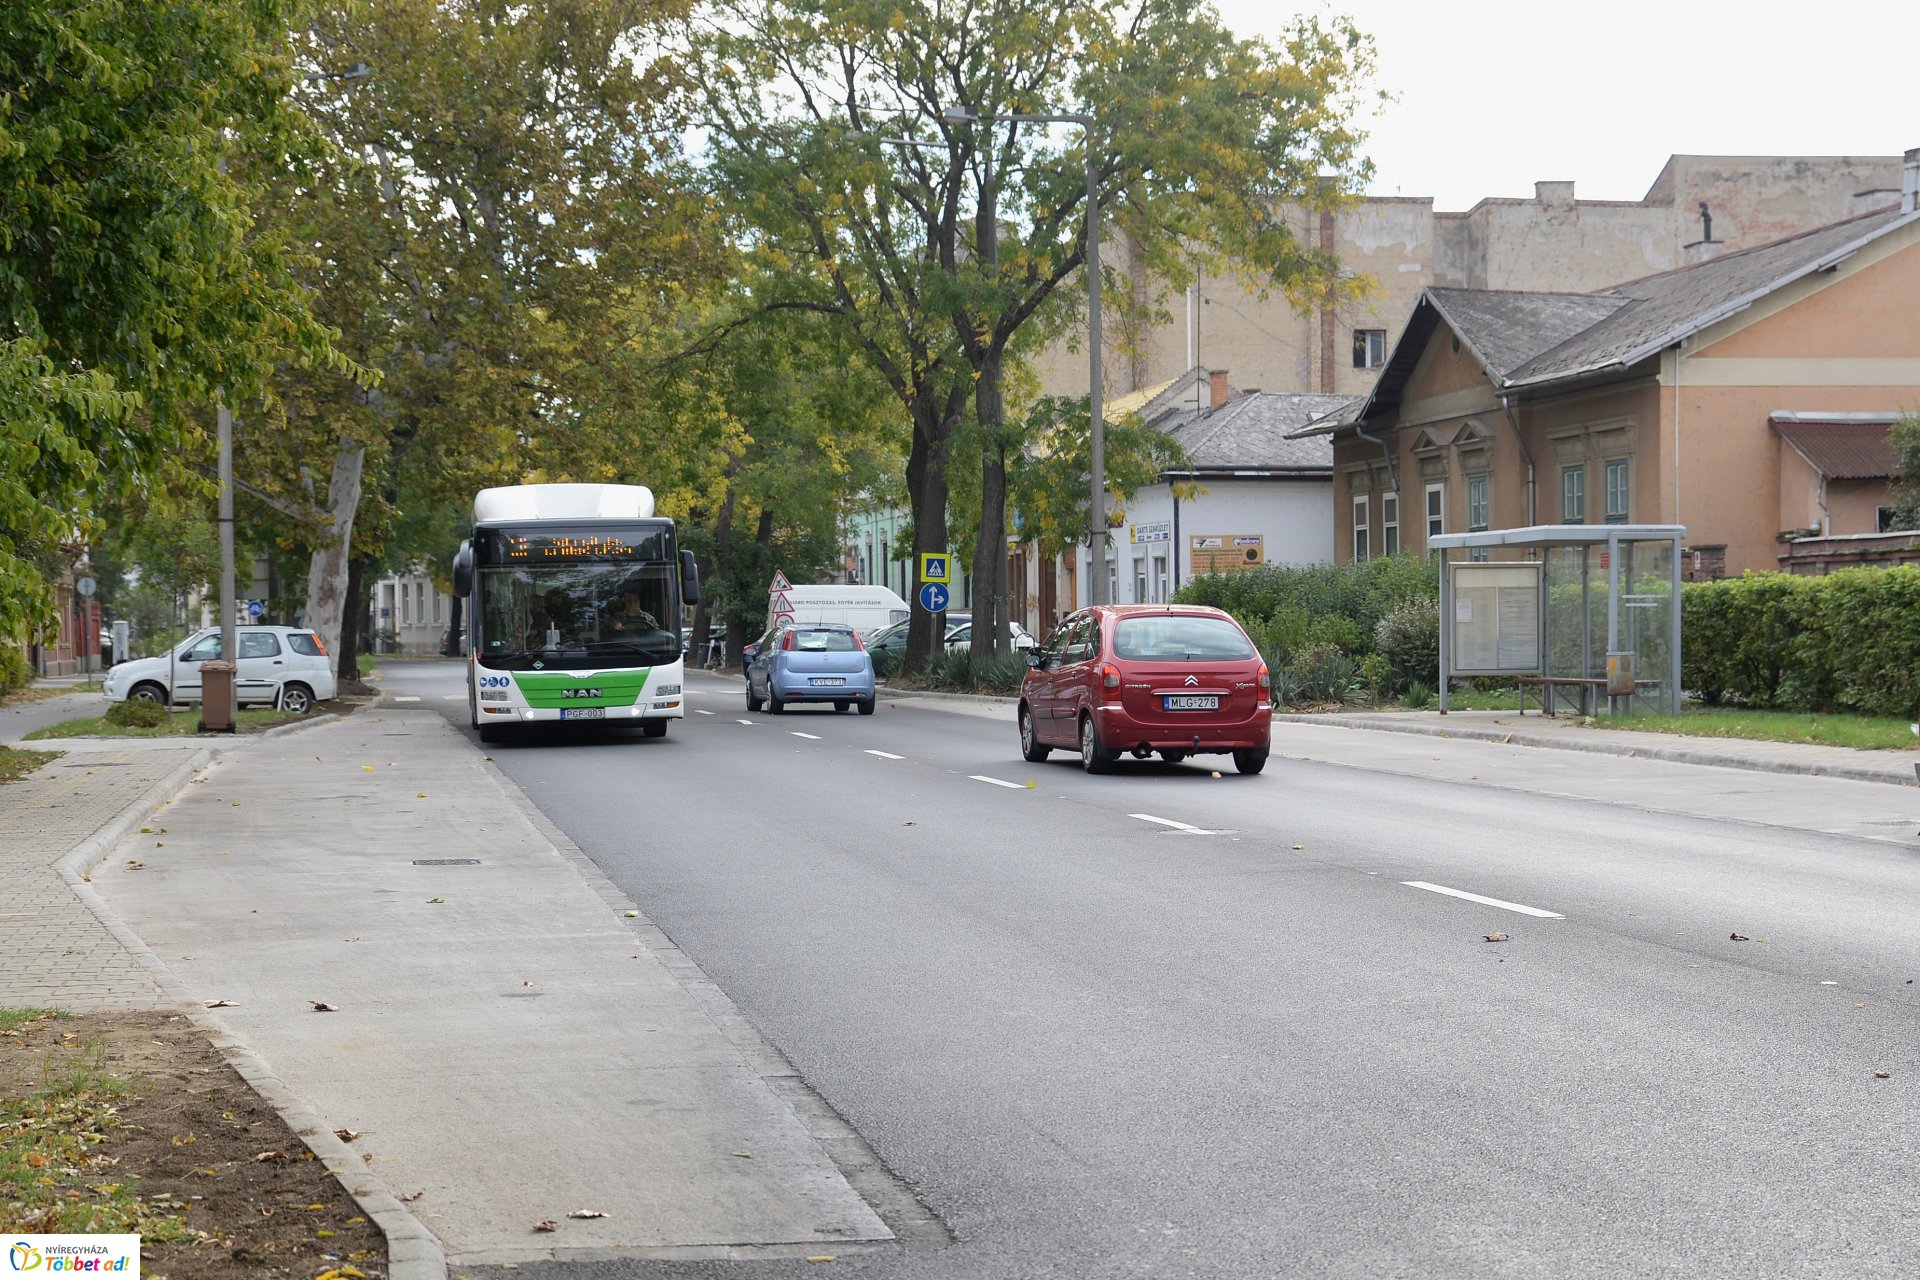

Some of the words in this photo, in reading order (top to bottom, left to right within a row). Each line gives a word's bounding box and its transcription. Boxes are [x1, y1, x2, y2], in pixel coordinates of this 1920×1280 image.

[562, 688, 602, 698] MAN
[1171, 698, 1216, 708] MLG-278
[567, 709, 603, 718] PGF-003
